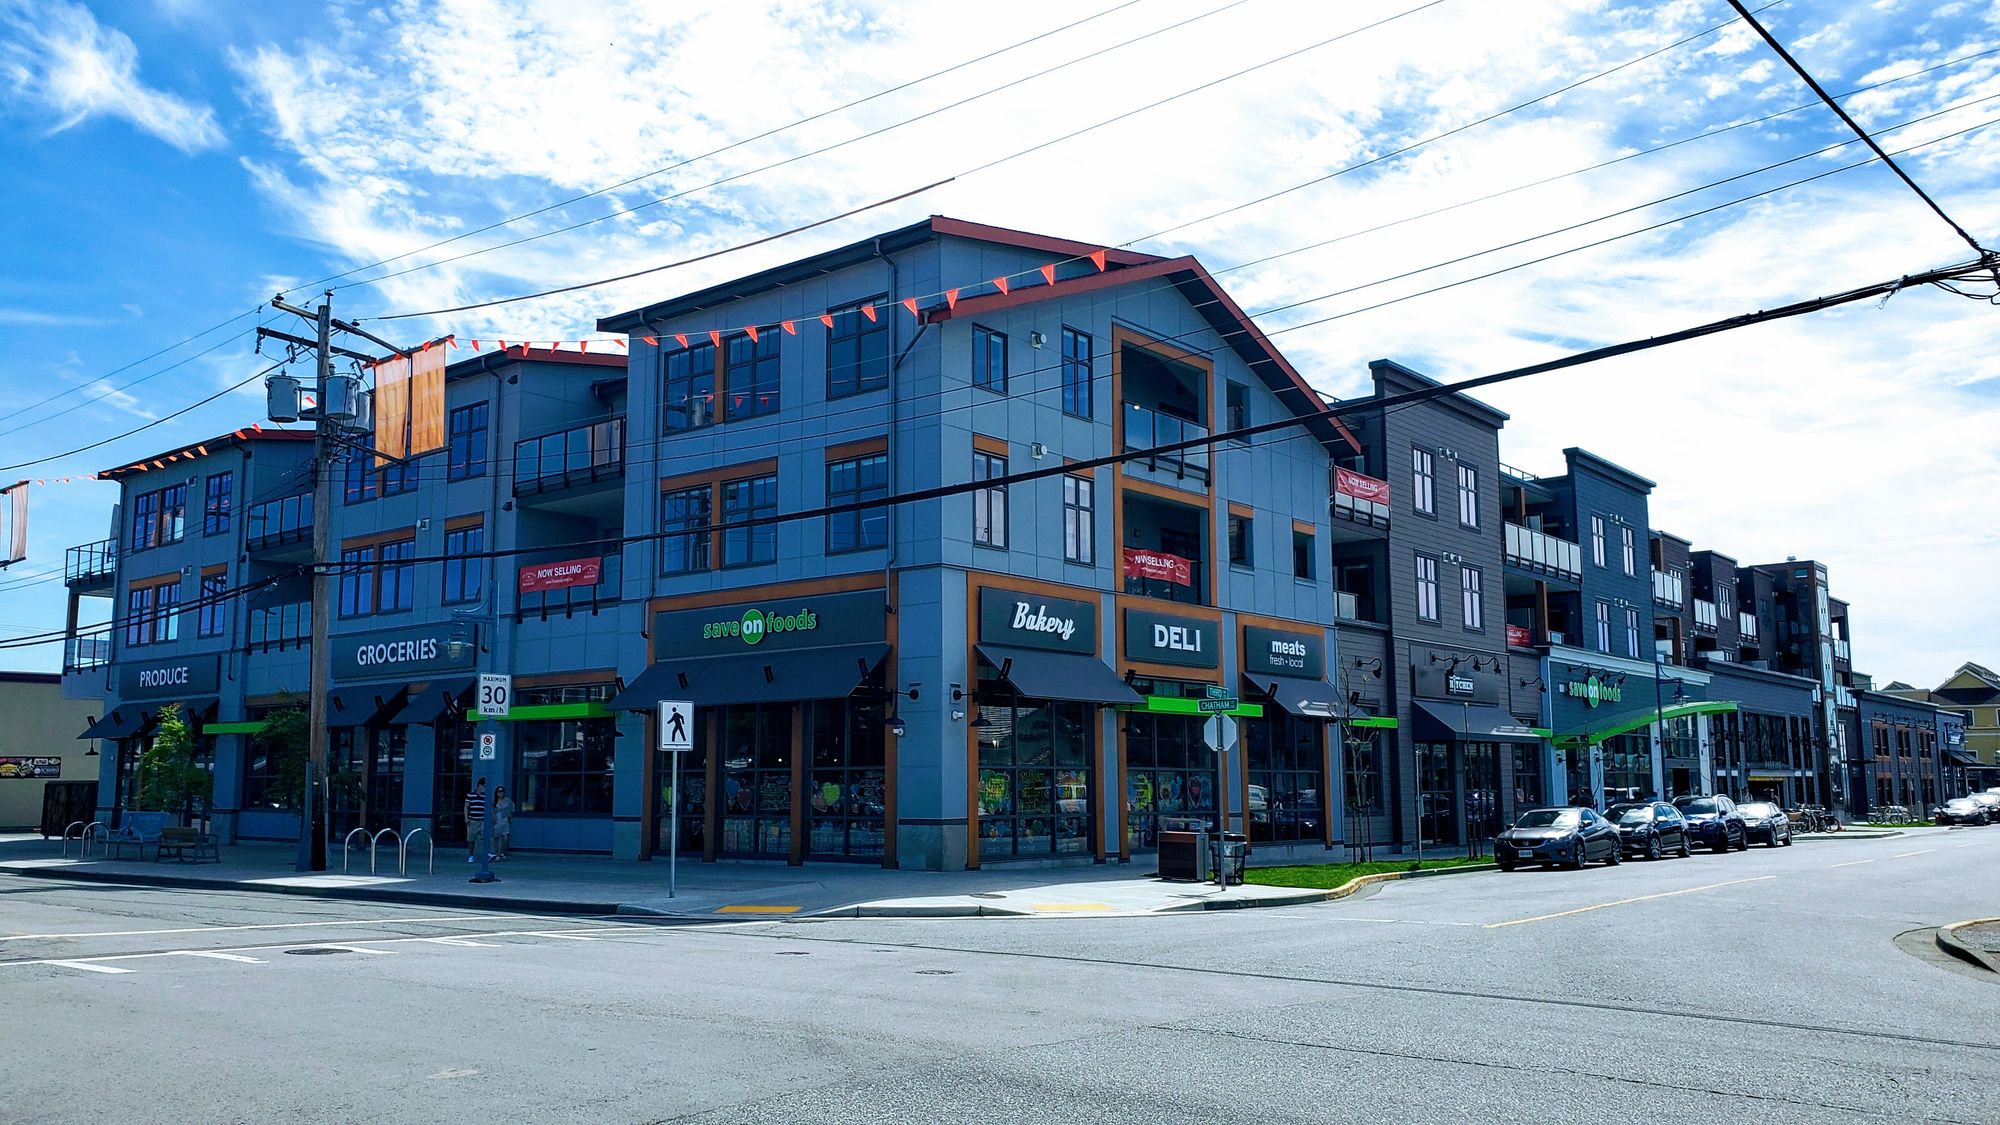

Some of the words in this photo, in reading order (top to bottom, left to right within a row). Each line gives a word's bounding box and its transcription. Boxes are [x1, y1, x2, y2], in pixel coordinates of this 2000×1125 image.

[537, 568, 553, 579] NOW
[554, 564, 582, 577] SELLING
[1147, 556, 1174, 569] SELLING
[704, 621, 739, 638] save
[743, 620, 762, 634] on
[766, 609, 816, 632] foods
[1012, 601, 1076, 641] Bakery
[1154, 623, 1201, 652] DELI
[357, 638, 437, 666] GROCERIES
[1271, 640, 1306, 657] meats
[1269, 654, 1285, 666] fresh
[1288, 656, 1304, 668] local
[139, 666, 188, 688] PRODUCE
[481, 685, 507, 705] 30
[1568, 681, 1588, 698] save
[1588, 685, 1599, 699] on
[1599, 680, 1621, 703] foods
[483, 706, 504, 714] km/h
[1201, 700, 1230, 710] CHATHAM
